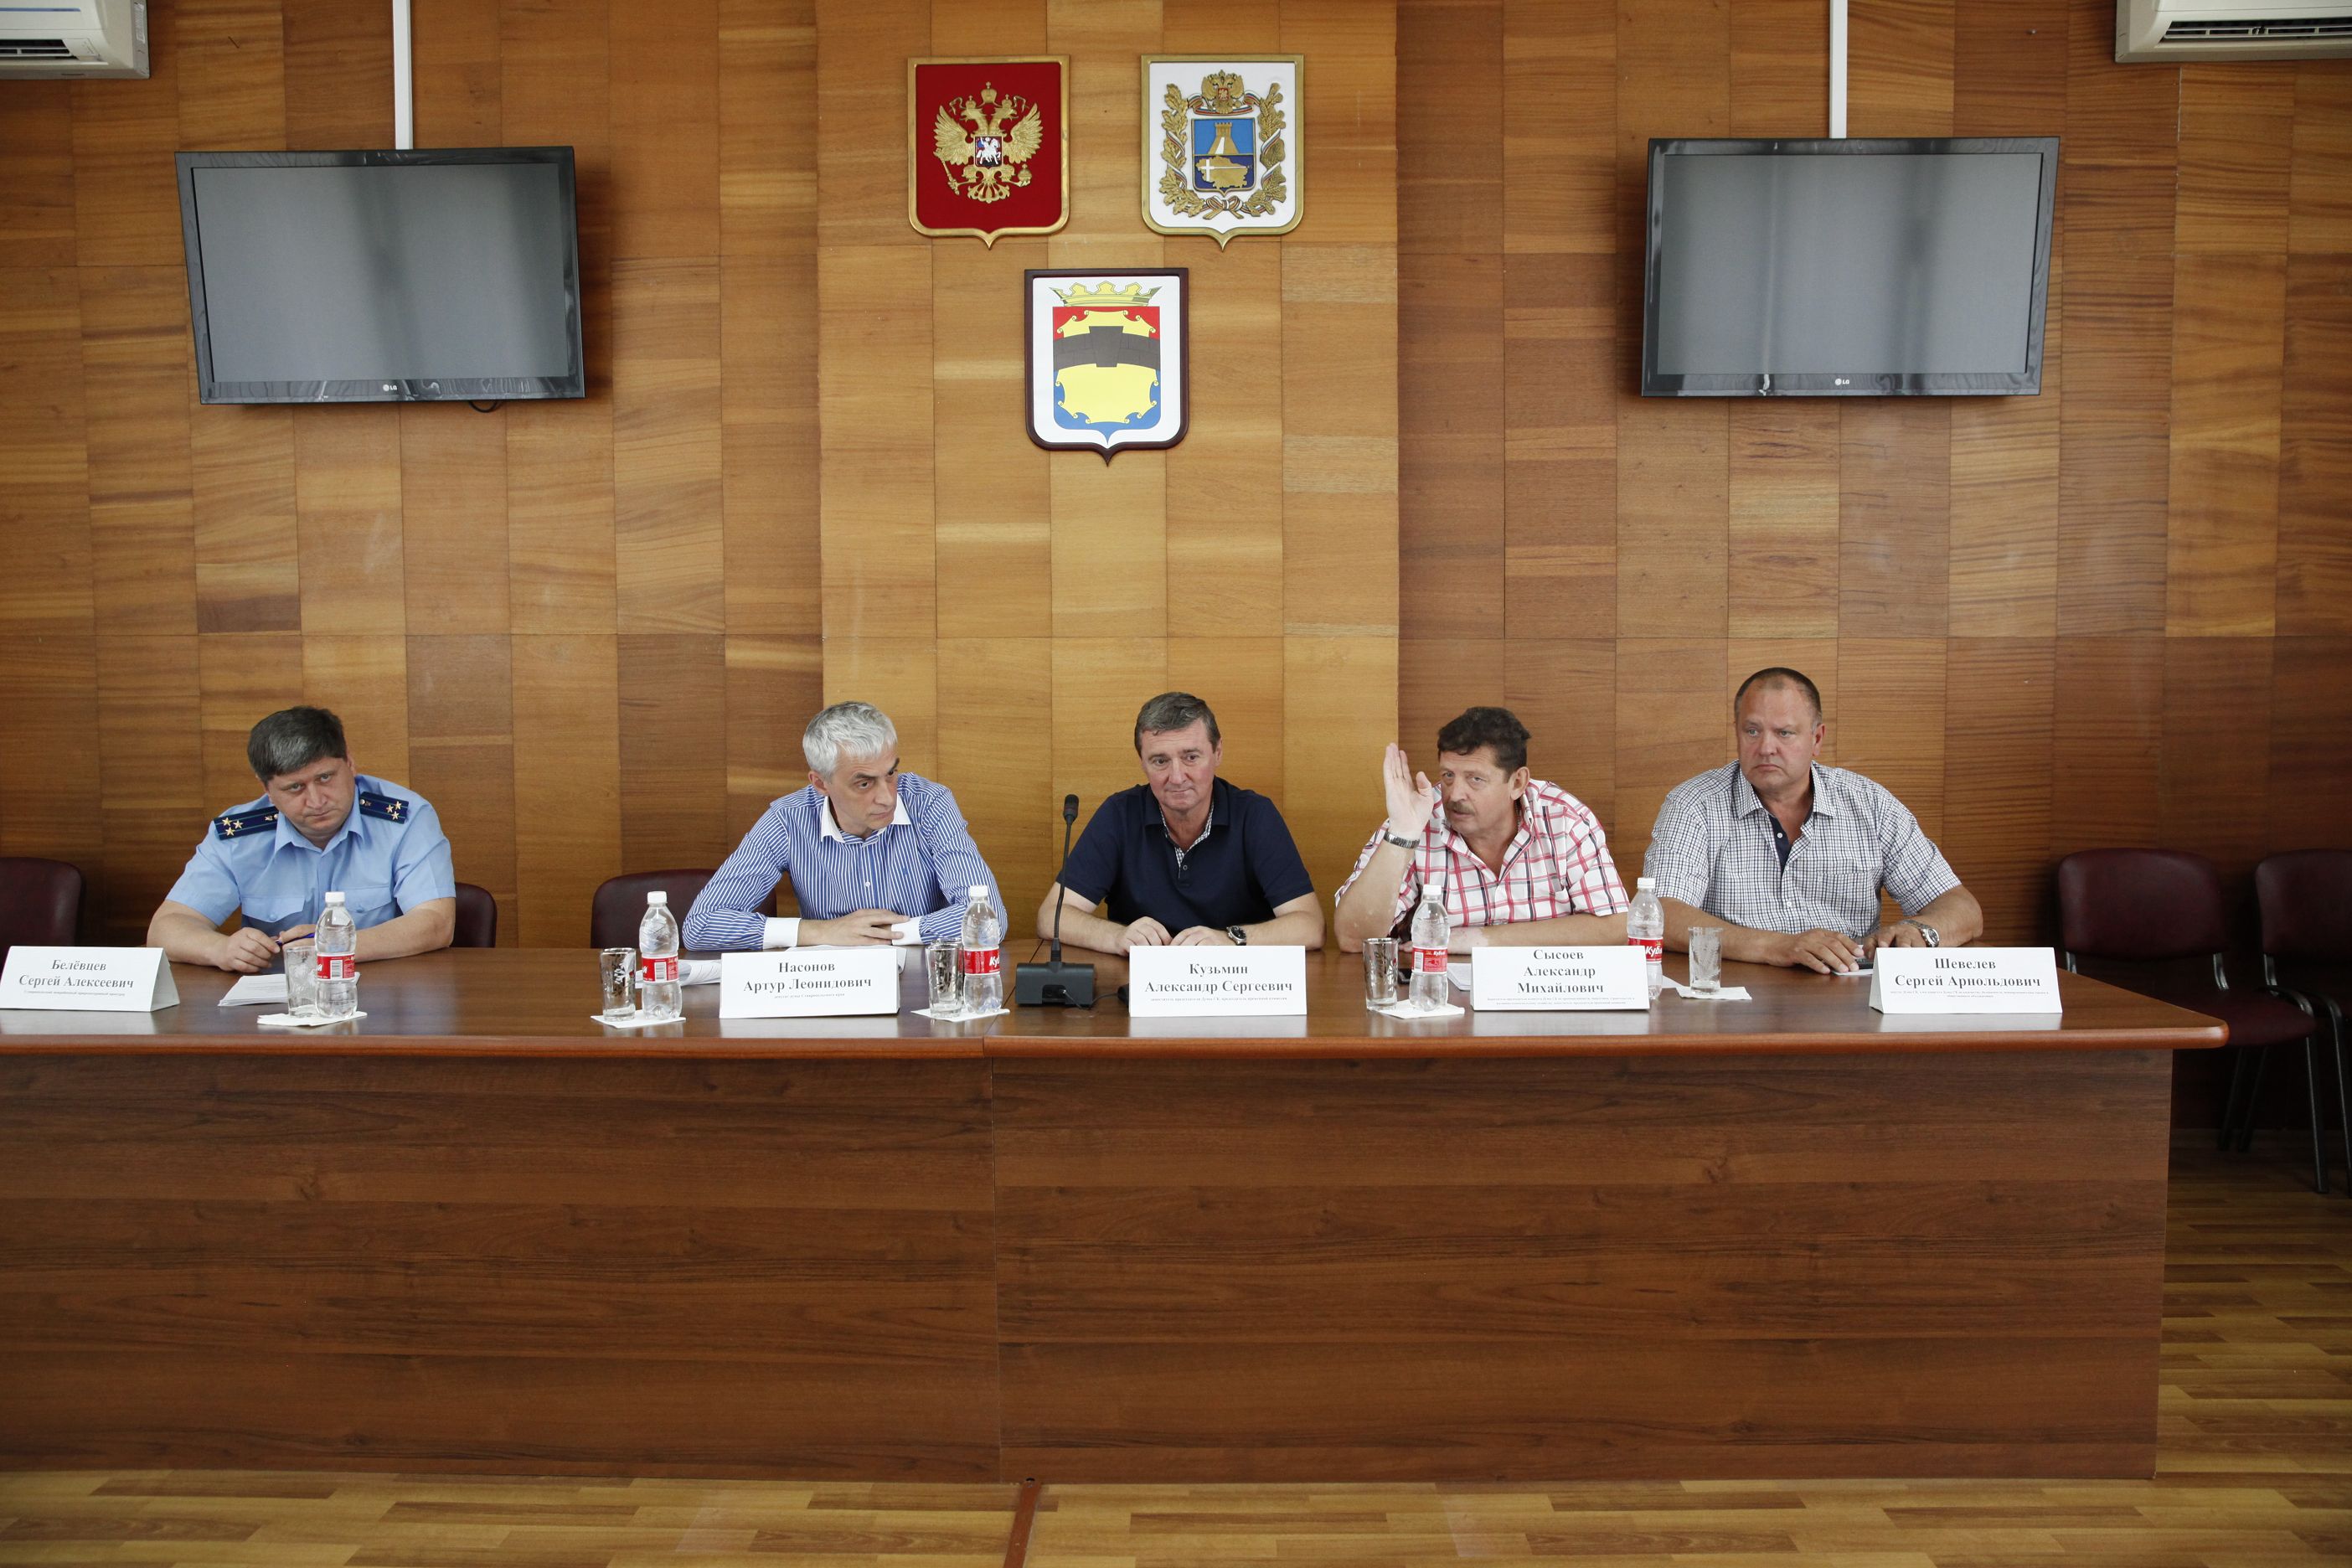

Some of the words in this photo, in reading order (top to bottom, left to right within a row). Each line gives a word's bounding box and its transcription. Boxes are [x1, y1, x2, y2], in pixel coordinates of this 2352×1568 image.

[1533, 949, 1584, 960] Сысоев
[51, 959, 107, 972] Белёвцев
[778, 962, 836, 973] Насонов
[1935, 957, 1997, 969] Шевелев
[1189, 963, 1248, 977] Кузьмин
[1524, 966, 1596, 978] Александр
[18, 974, 61, 988] Сергей
[64, 976, 134, 989] Алексеевич
[743, 980, 786, 994] Артур
[788, 977, 872, 991] Леонидович
[1144, 981, 1219, 995] Александр
[1222, 979, 1292, 995] Сергеевич
[1517, 982, 1604, 994] Михайлович
[1894, 975, 1944, 989] Сергей
[1948, 976, 2040, 989] Арнольдович
